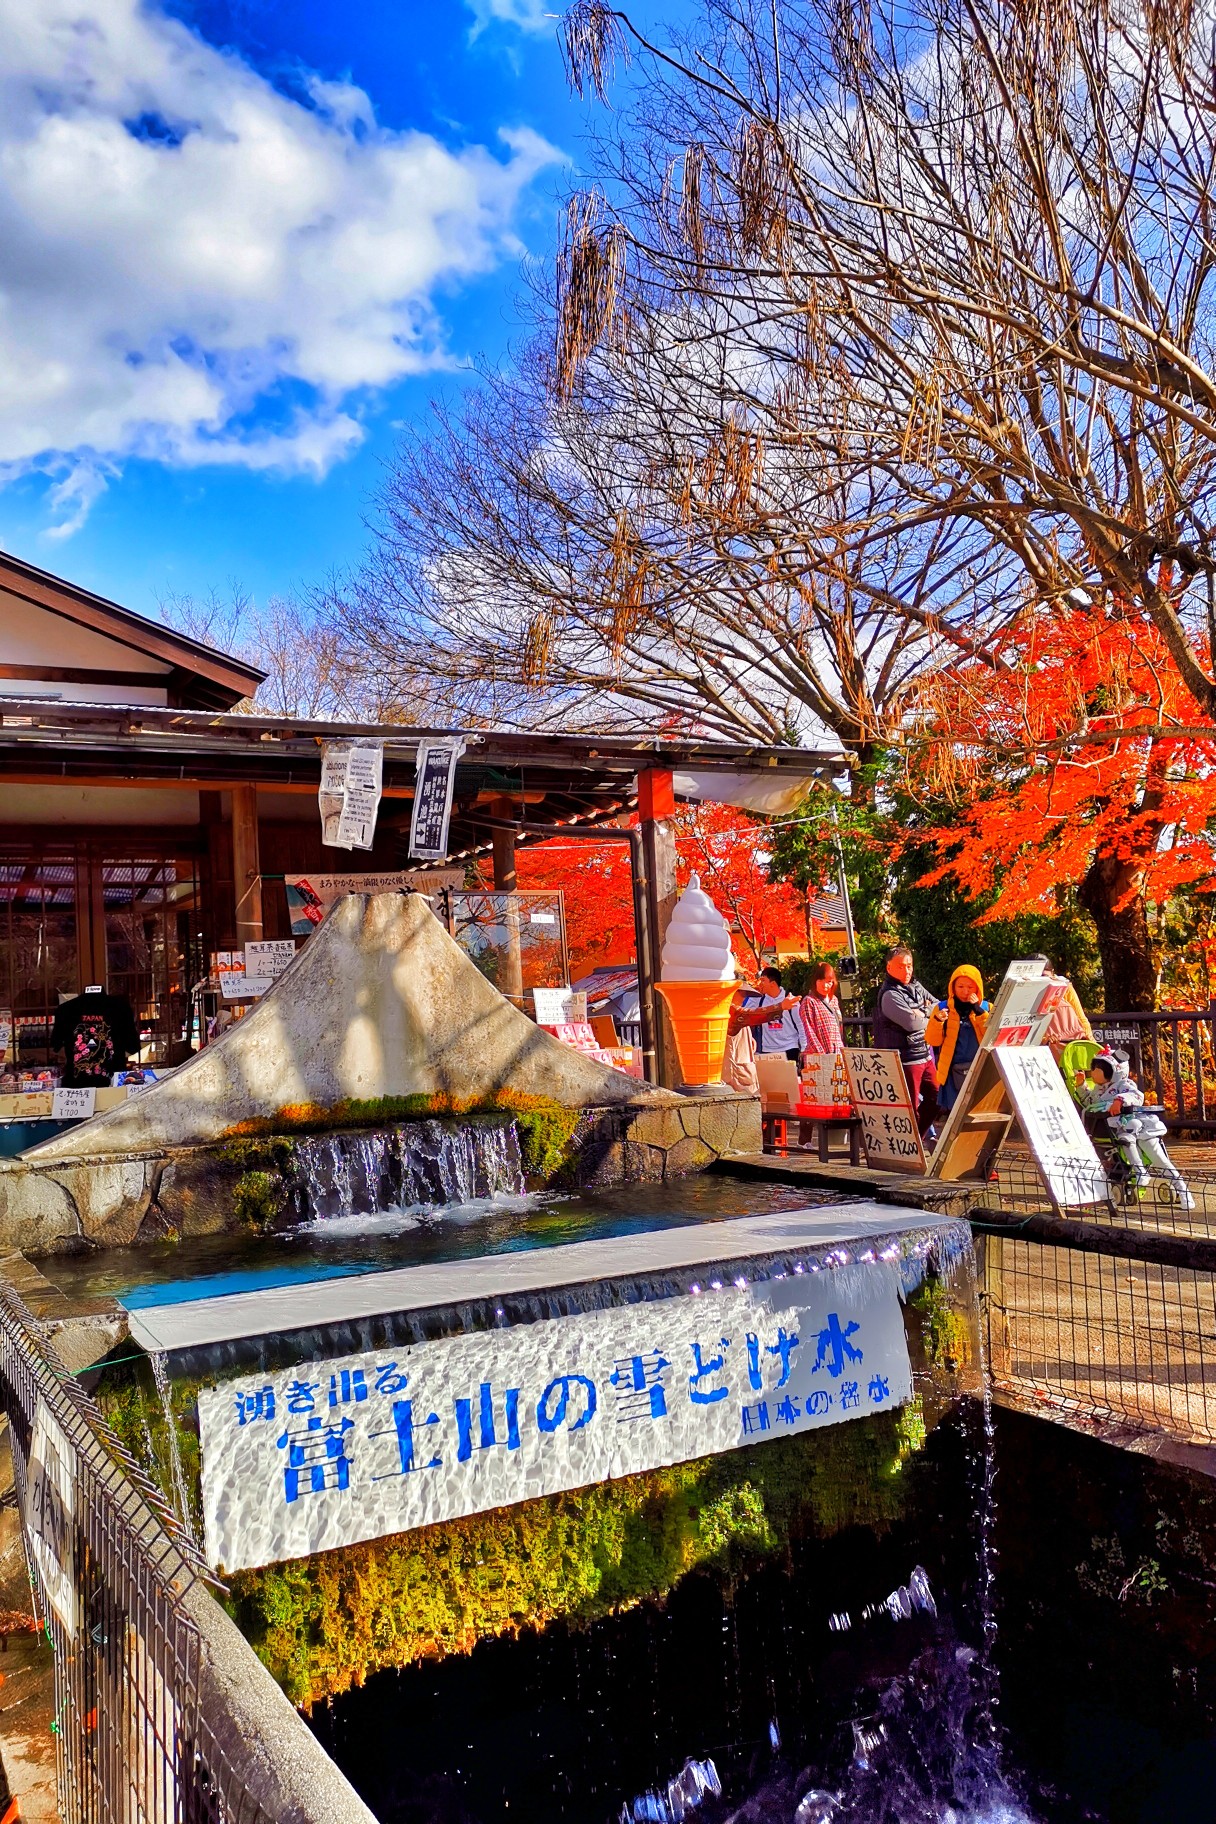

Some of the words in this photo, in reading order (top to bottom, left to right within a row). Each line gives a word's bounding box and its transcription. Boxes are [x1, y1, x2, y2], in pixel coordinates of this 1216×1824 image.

[1104, 1029, 1139, 1040] 駐輪禁止
[851, 1052, 889, 1077] 桃茶
[856, 1077, 900, 1103] 160g
[881, 1113, 913, 1135] ¥650
[886, 1136, 919, 1156] ¥1200
[234, 1361, 408, 1426] 湧き出る
[276, 1313, 864, 1504] 富士山の雪どけ水
